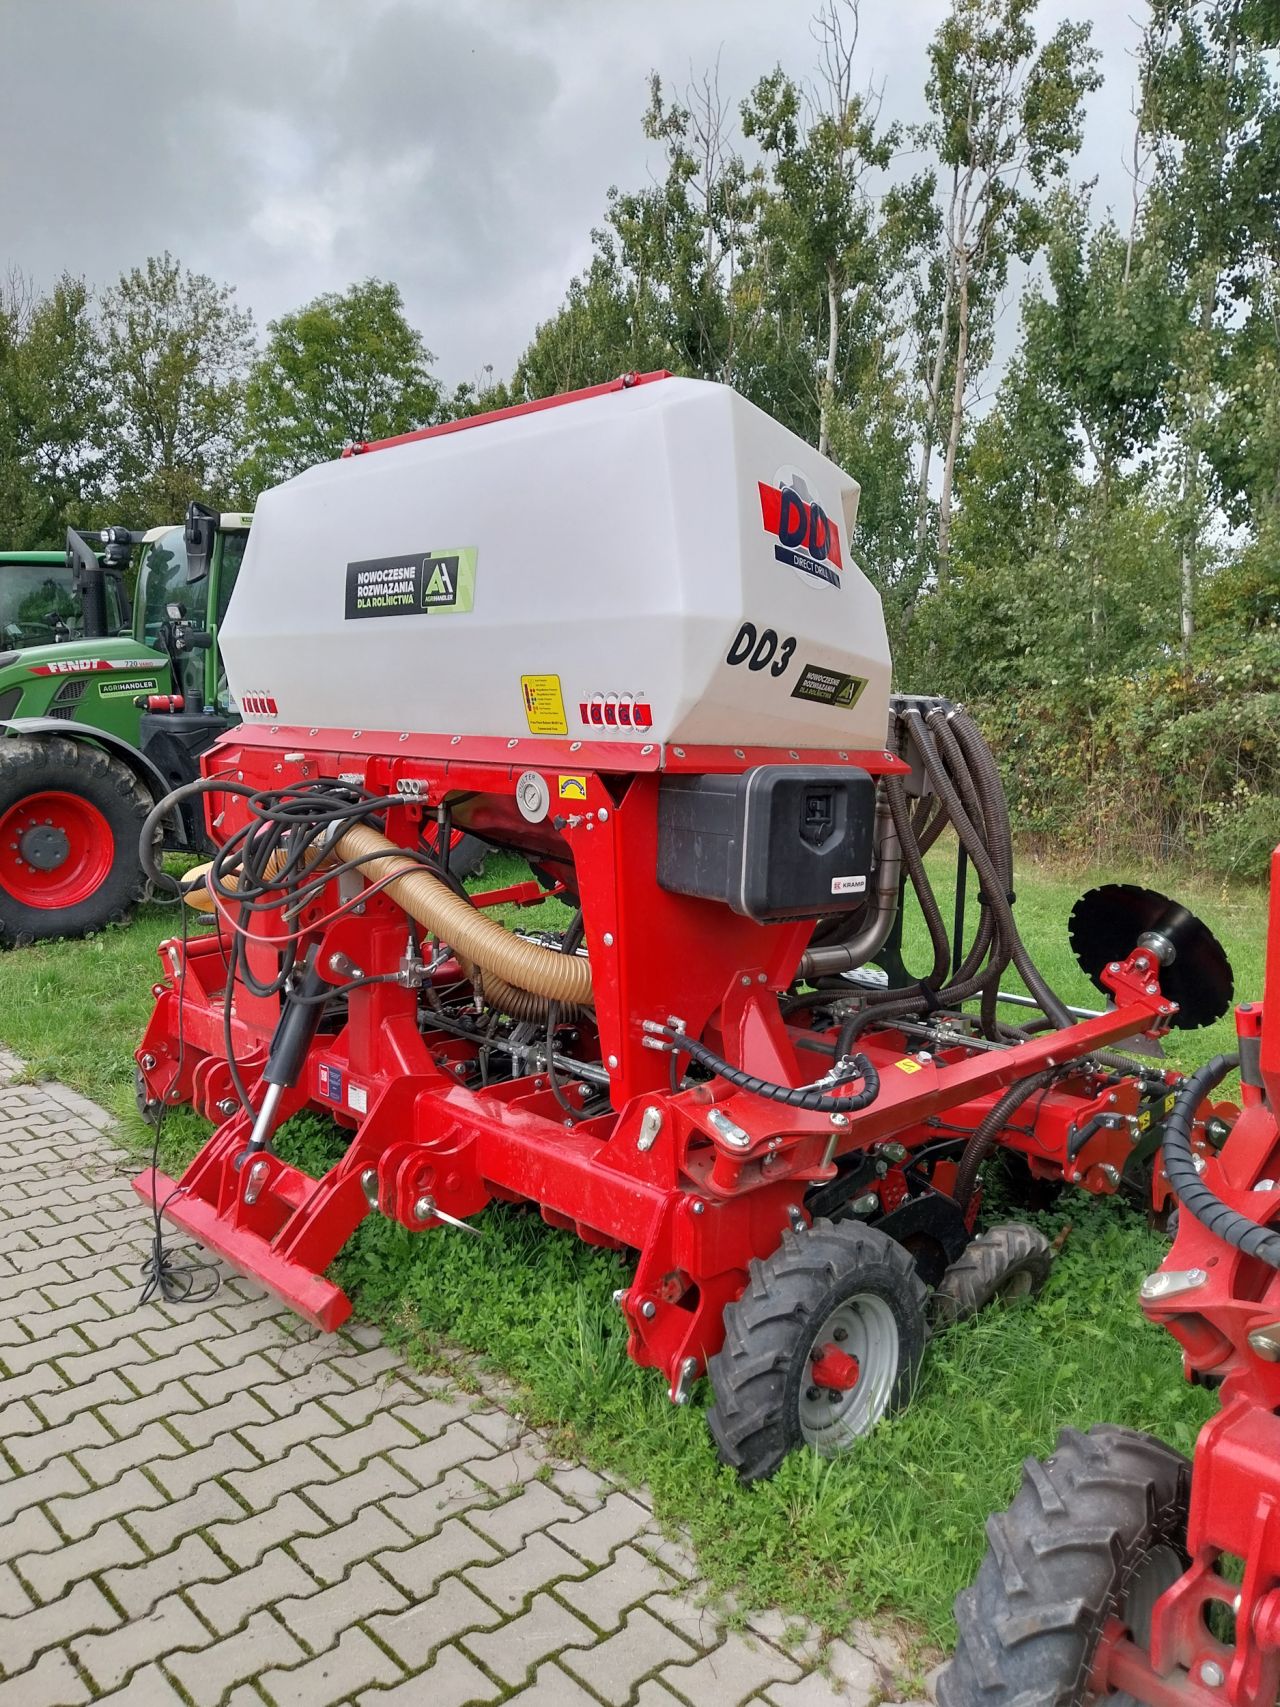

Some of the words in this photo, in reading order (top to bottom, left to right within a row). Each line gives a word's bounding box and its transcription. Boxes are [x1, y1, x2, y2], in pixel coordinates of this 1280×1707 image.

[793, 555, 814, 571] DIRECT
[814, 564, 829, 580] DRILL
[357, 566, 416, 585] NOWOCZESNE
[357, 581, 415, 597] ROZWIĄZANIA
[357, 598, 372, 609] DLA
[372, 594, 414, 607] ROLNICTWA
[425, 594, 454, 603] AGRIHANDLER
[726, 621, 797, 678] DD3
[46, 658, 101, 673] FENDT
[124, 660, 138, 668] 720
[805, 672, 841, 686] NOWOCZESNE
[103, 681, 153, 693] AGRIHANDLER
[517, 773, 536, 799] COULTER
